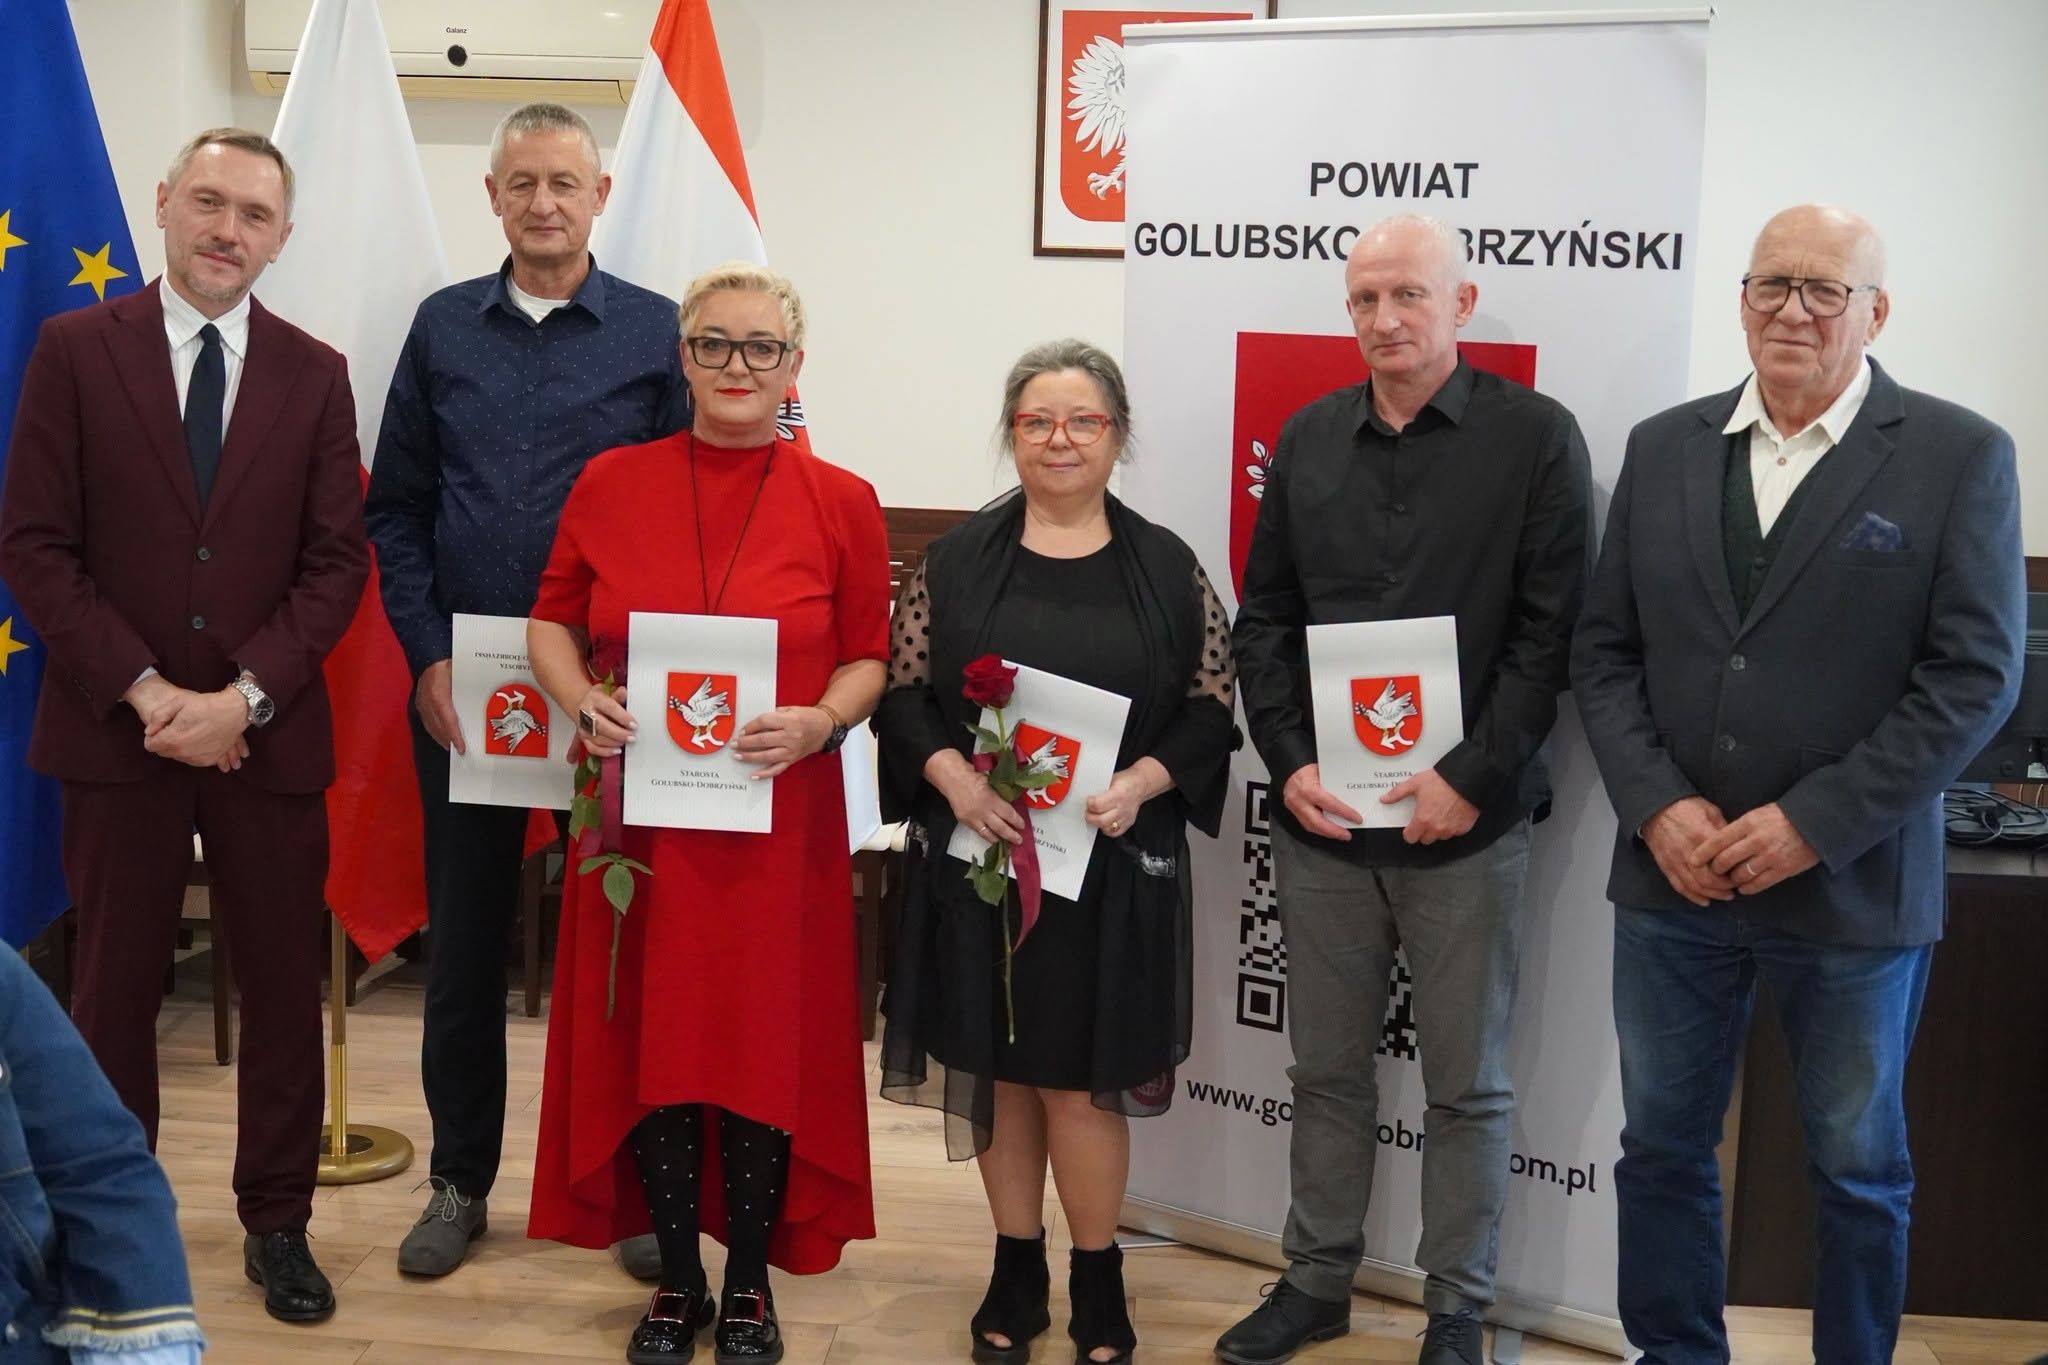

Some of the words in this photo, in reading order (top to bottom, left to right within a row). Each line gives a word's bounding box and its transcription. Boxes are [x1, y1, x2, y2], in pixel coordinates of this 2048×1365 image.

[1308, 161, 1479, 199] POWIAT
[499, 662, 532, 672] TAROSTA
[679, 769, 720, 779] STAROSTA
[1373, 770, 1413, 779] STAROSTA
